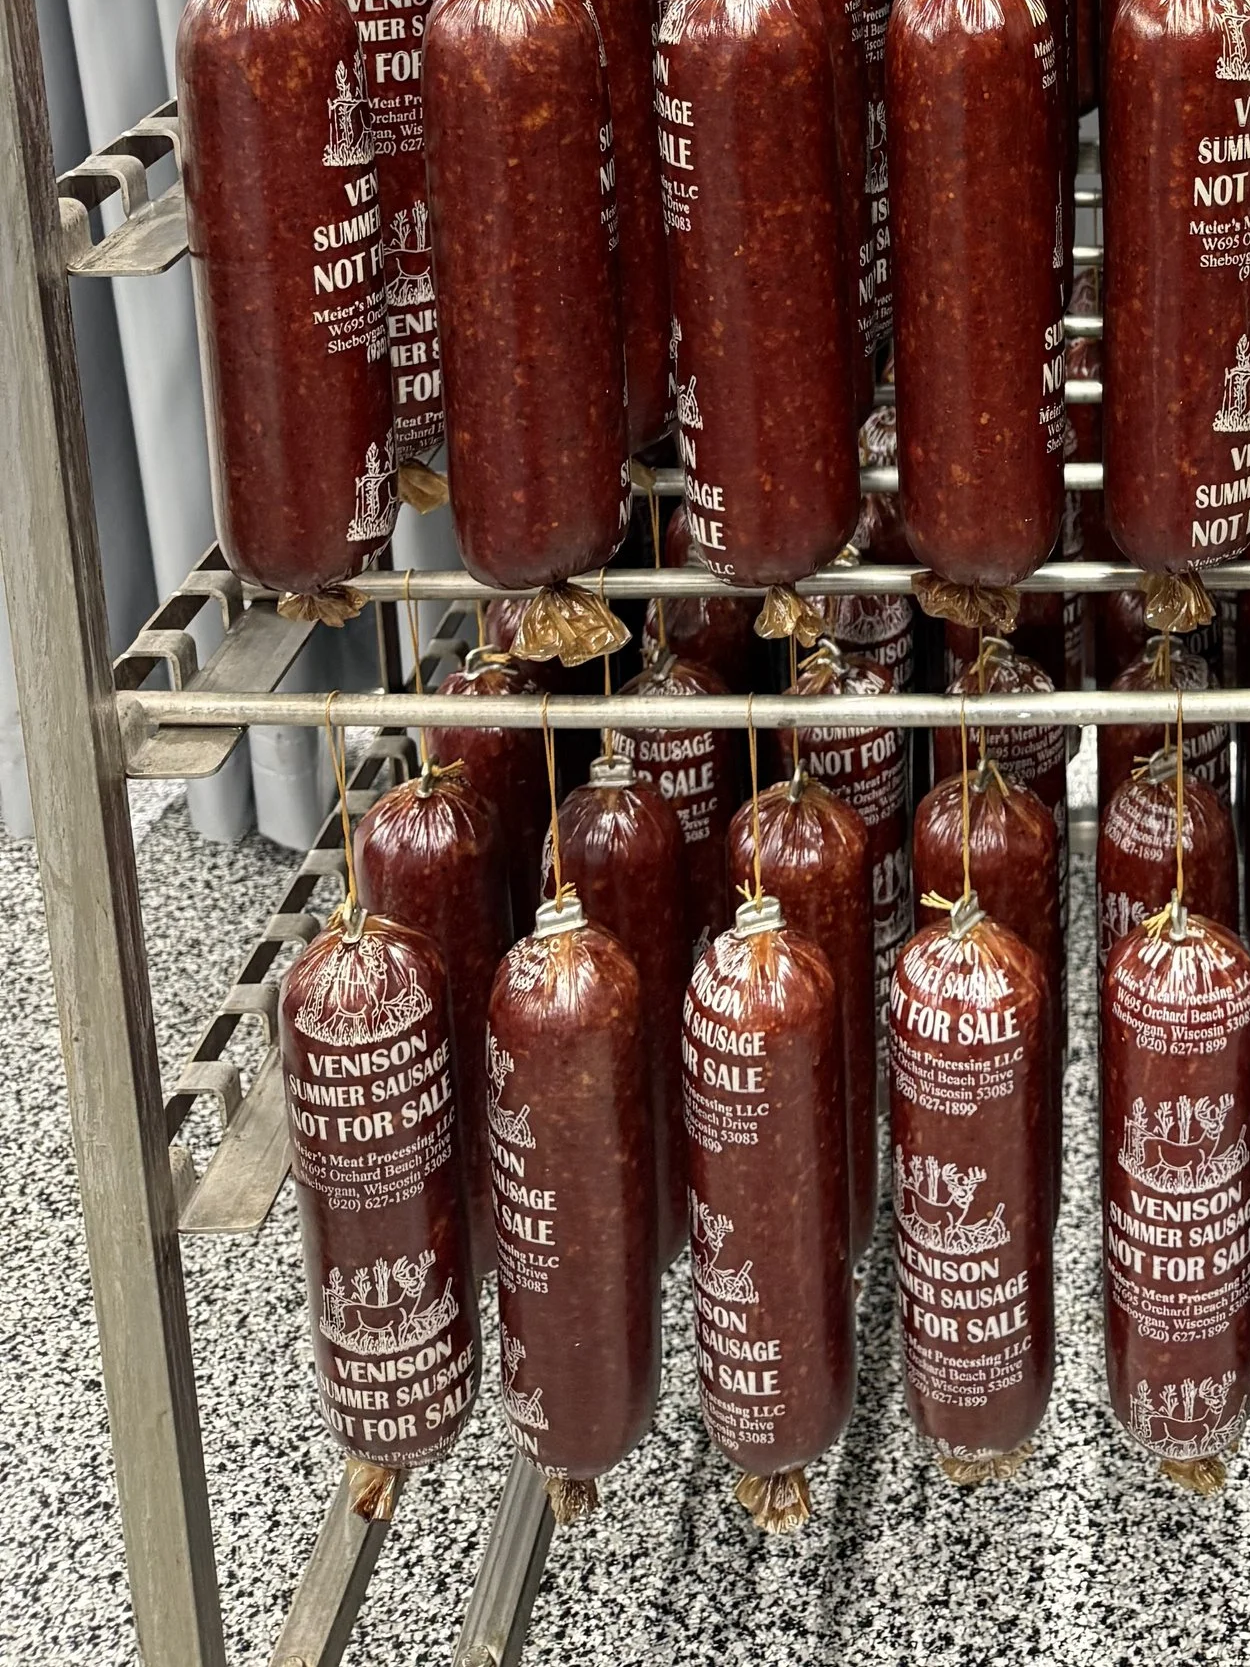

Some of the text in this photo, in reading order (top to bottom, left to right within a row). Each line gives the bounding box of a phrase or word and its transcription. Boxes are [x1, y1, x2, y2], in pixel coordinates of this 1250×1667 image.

[674, 181, 699, 200] LLC
[1193, 172, 1249, 207] NOT
[1189, 217, 1241, 236] Meier's
[1202, 236, 1240, 251] W695
[313, 252, 366, 295] NOT
[312, 300, 364, 326] Meier's
[328, 315, 364, 337] W695
[1192, 513, 1243, 548] NOT
[809, 731, 896, 777] NOT FOR
[907, 1000, 1021, 1046] FOR SALE
[1142, 1004, 1187, 1024] Orchard
[691, 1012, 767, 1057] SAUSAGE
[306, 1029, 428, 1079] VENISON
[371, 1038, 451, 1103] SAUSAGE
[703, 1058, 766, 1094] SALE
[722, 1114, 758, 1131] Drive
[735, 1102, 770, 1117] LLC
[336, 1111, 395, 1143] FOR
[720, 1130, 759, 1146] 53083
[1130, 1180, 1242, 1223] VENISON
[502, 1211, 556, 1247] SALE
[516, 1262, 549, 1281] Drive
[528, 1249, 560, 1269] LLC
[1152, 1255, 1206, 1283] FOR
[940, 1270, 1029, 1310] SAUSAGE
[913, 1304, 959, 1343] FOR
[334, 1334, 452, 1383] VENISON
[718, 1365, 781, 1396] SALE
[739, 1418, 774, 1431] Drive
[752, 1404, 787, 1418] LLC
[362, 1414, 418, 1443] FOR
